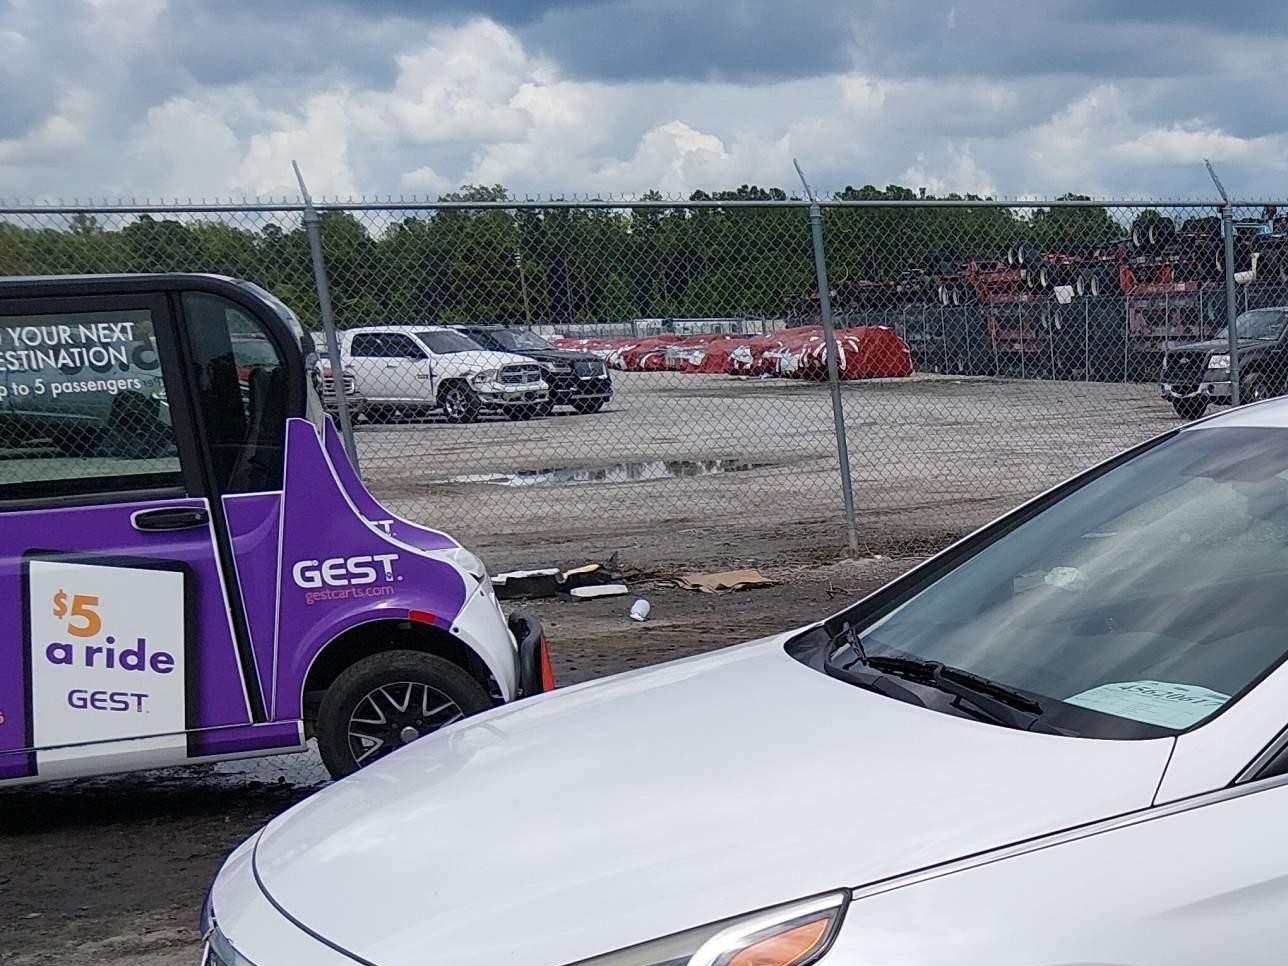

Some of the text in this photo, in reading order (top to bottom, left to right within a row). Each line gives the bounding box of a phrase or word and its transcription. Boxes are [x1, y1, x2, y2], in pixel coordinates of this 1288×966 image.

[6, 325, 72, 346] YOUR
[78, 322, 135, 344] NEXT
[12, 382, 30, 396] to
[34, 378, 46, 395] 5
[51, 378, 142, 398] passengers
[292, 554, 399, 588] GEST
[305, 585, 395, 605] gestcarts.com
[53, 589, 102, 638] $5
[45, 636, 175, 674] a ride
[67, 689, 149, 713] GEST
